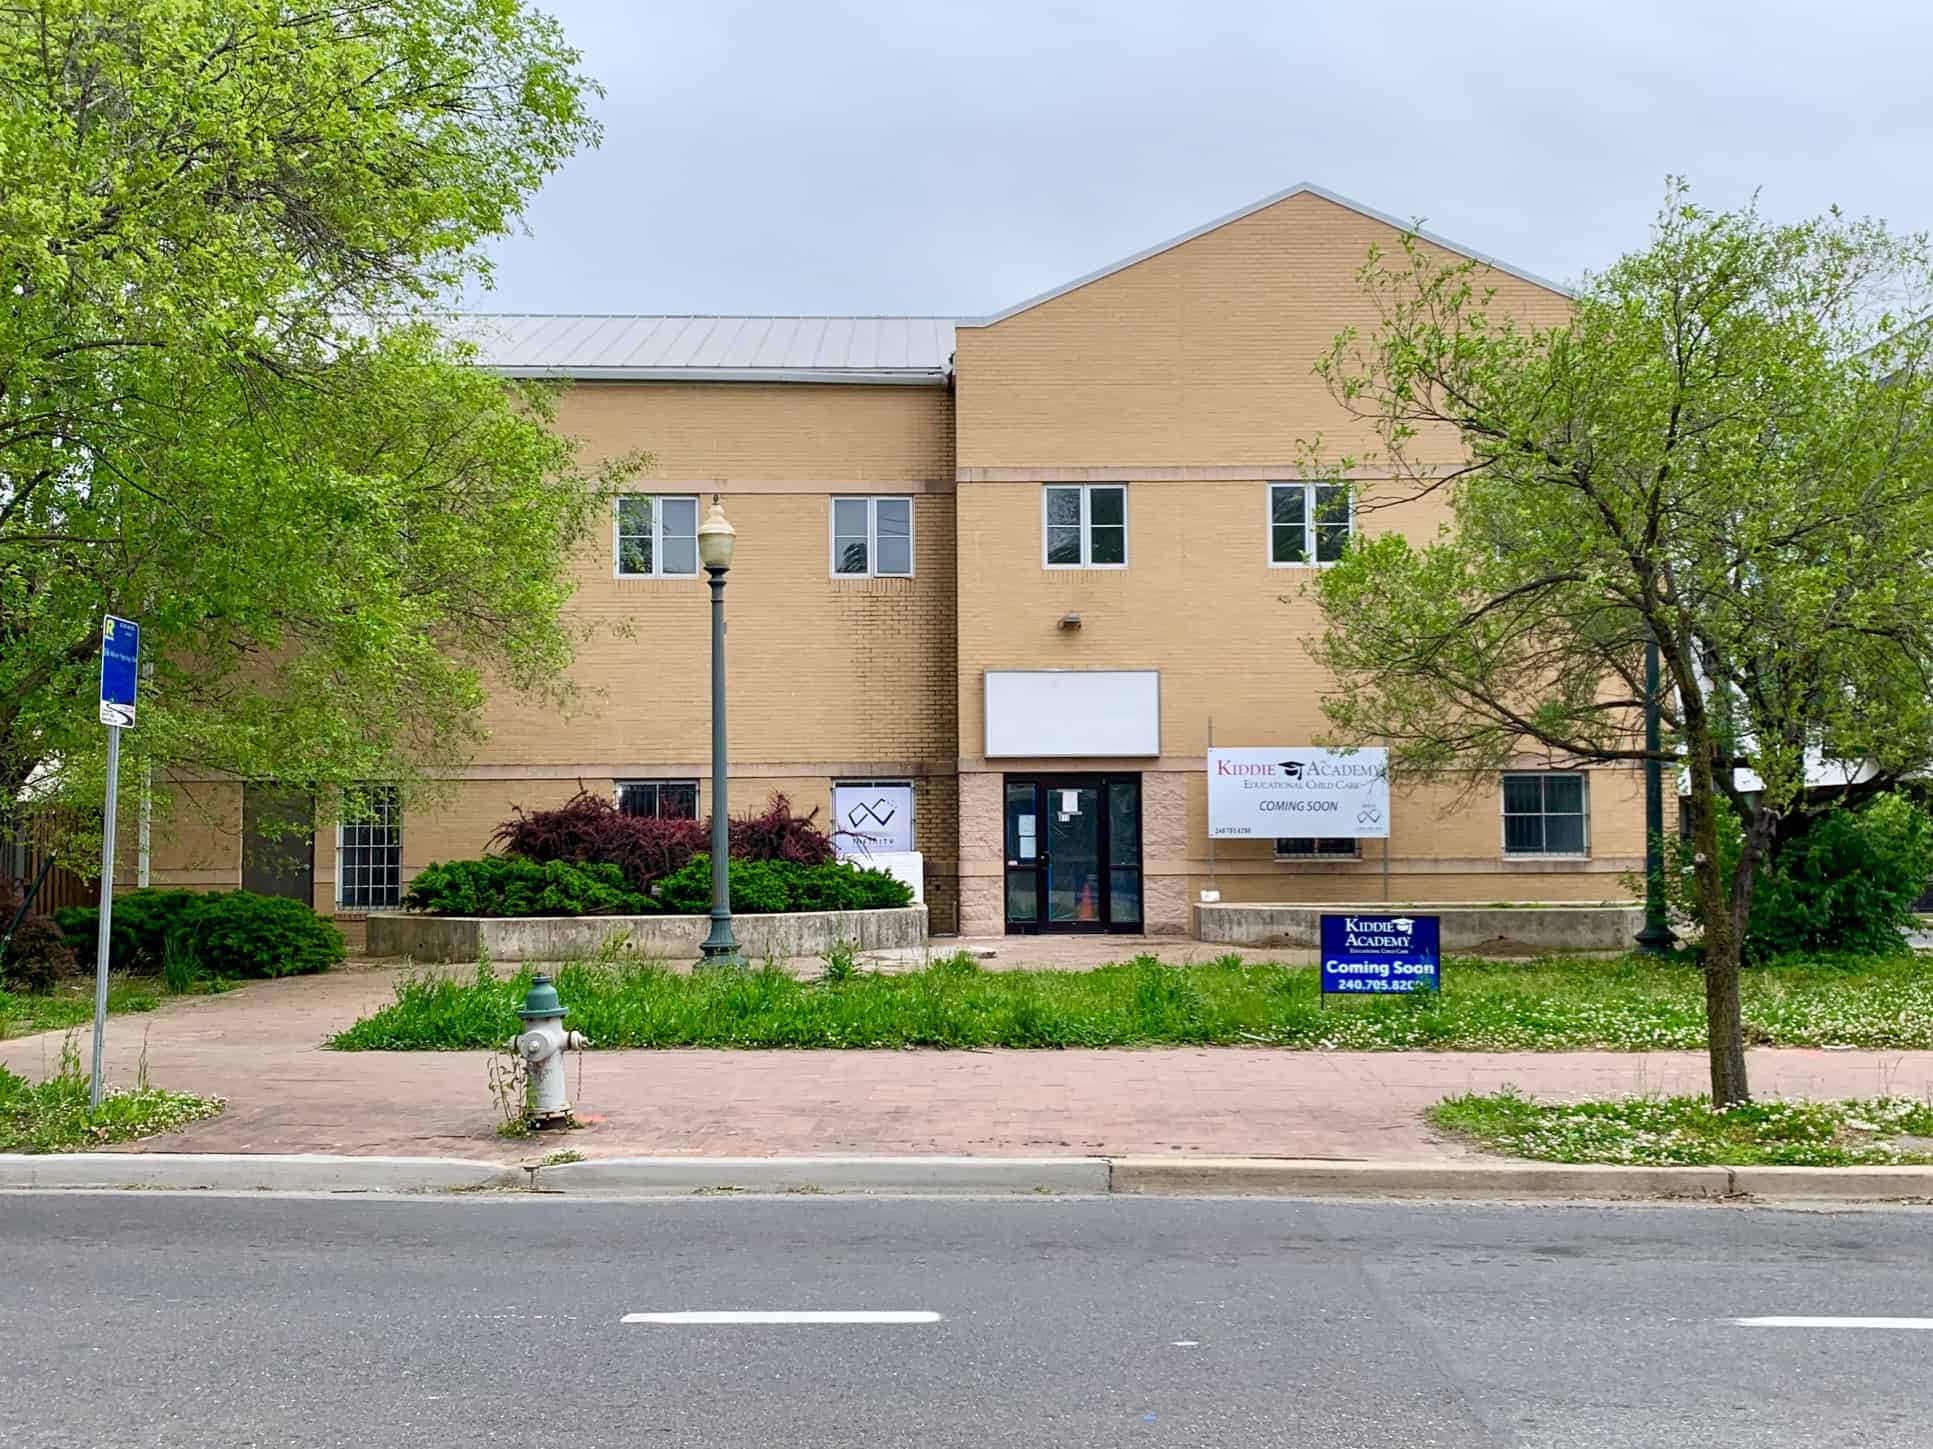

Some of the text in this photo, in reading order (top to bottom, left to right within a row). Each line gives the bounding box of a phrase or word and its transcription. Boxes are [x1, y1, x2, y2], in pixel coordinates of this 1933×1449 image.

[1216, 760, 1277, 776] KIDDIE
[1259, 800, 1338, 812] COMING SOON
[1344, 918, 1395, 932] KIDDIE
[1345, 933, 1410, 947] ACADEMY
[1326, 960, 1435, 977] Coming Soon
[1338, 979, 1423, 990] 240.705.820
